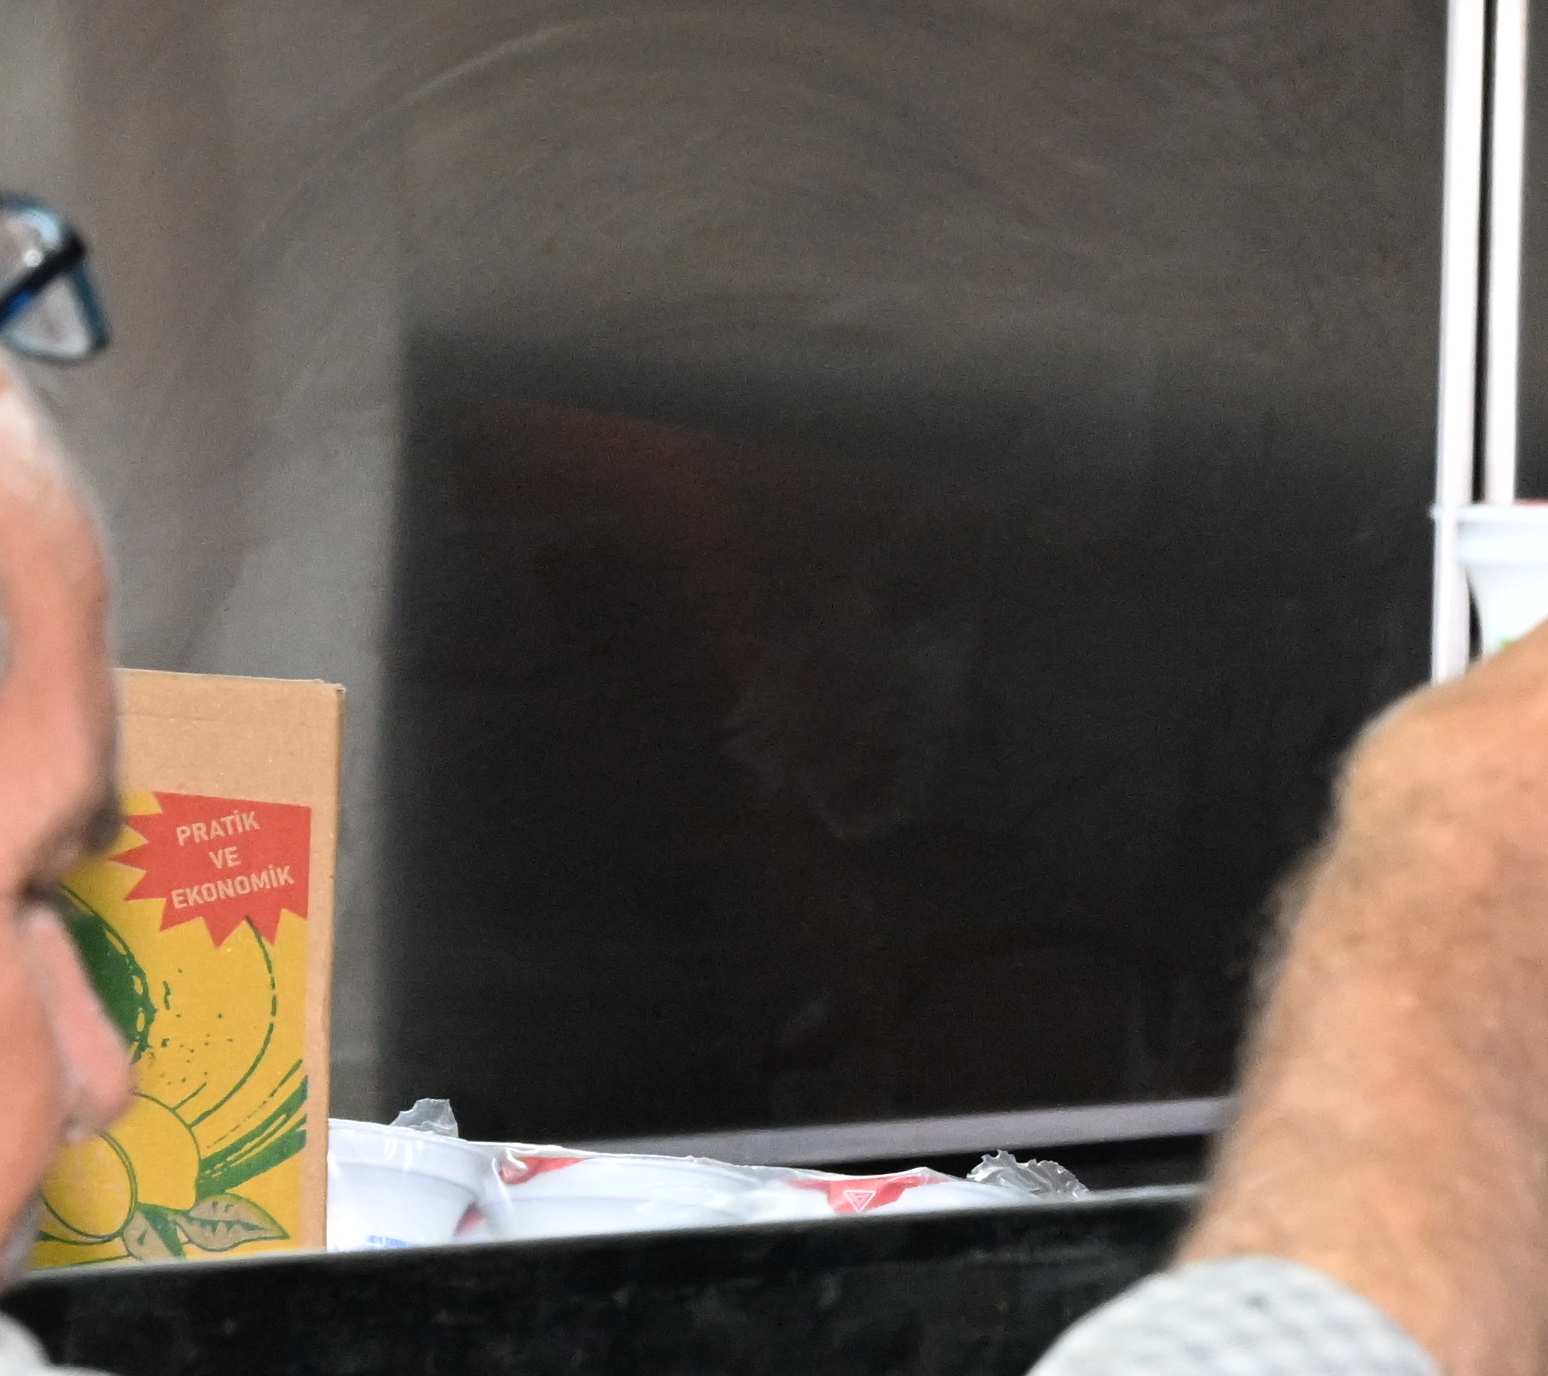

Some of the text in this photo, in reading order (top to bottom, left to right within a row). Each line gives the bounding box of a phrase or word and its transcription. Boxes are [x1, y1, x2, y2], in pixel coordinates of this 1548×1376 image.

[175, 809, 261, 847] PRATİK
[208, 846, 242, 870] VE
[170, 864, 295, 910] EKONOMİK
